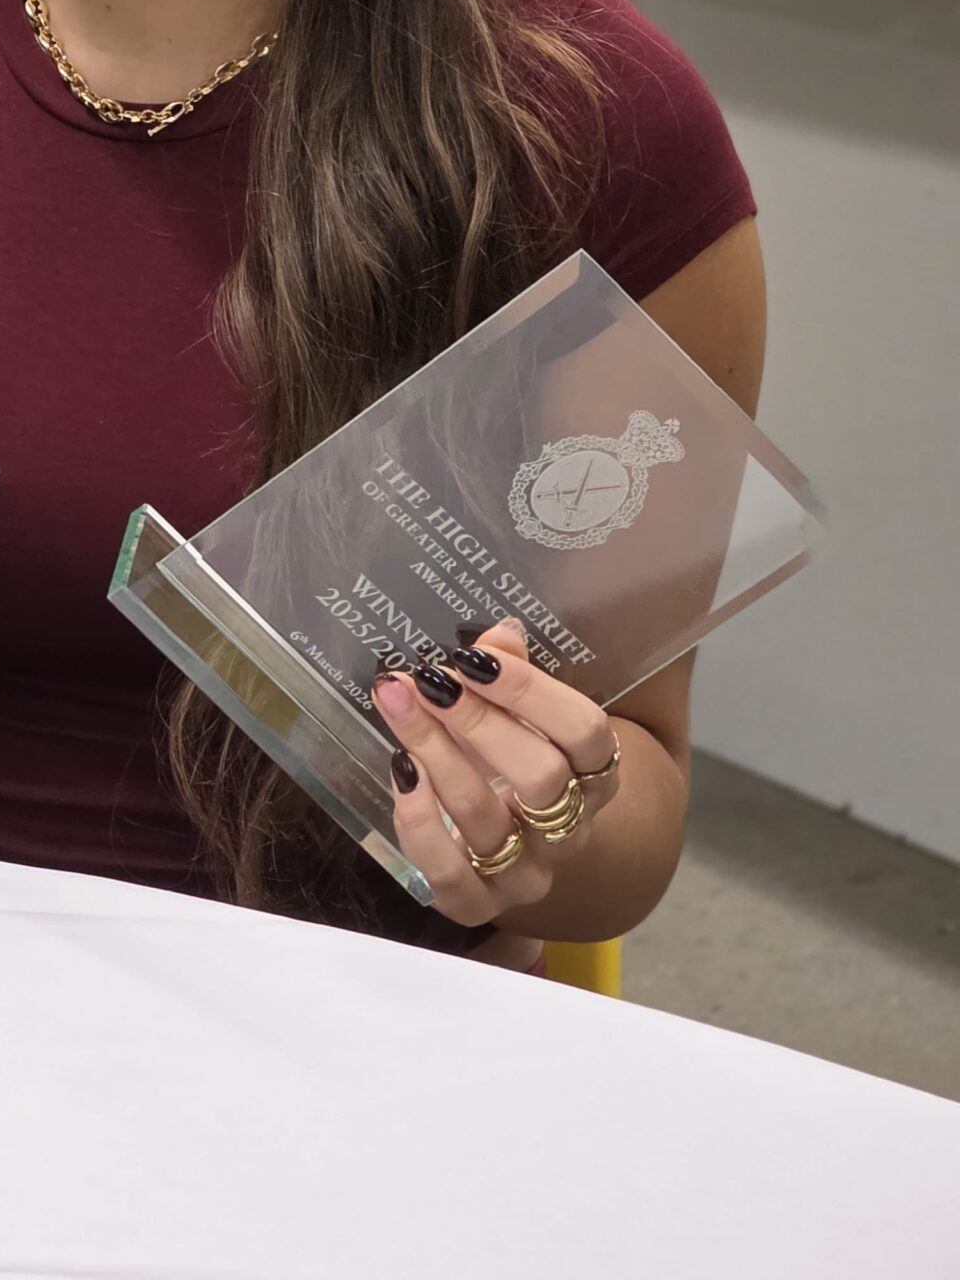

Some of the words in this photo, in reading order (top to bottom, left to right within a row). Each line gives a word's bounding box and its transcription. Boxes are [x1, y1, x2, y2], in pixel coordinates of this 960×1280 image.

[362, 480, 389, 502] OF
[384, 503, 457, 573] GREATER
[375, 454, 431, 509] THE
[423, 505, 498, 575] HIGH
[491, 572, 596, 664] SHERIFF
[352, 573, 447, 665] WINNER
[409, 561, 477, 621] AWARDS
[289, 631, 309, 644] 6th
[306, 644, 343, 682] March
[341, 679, 374, 710] 2026
